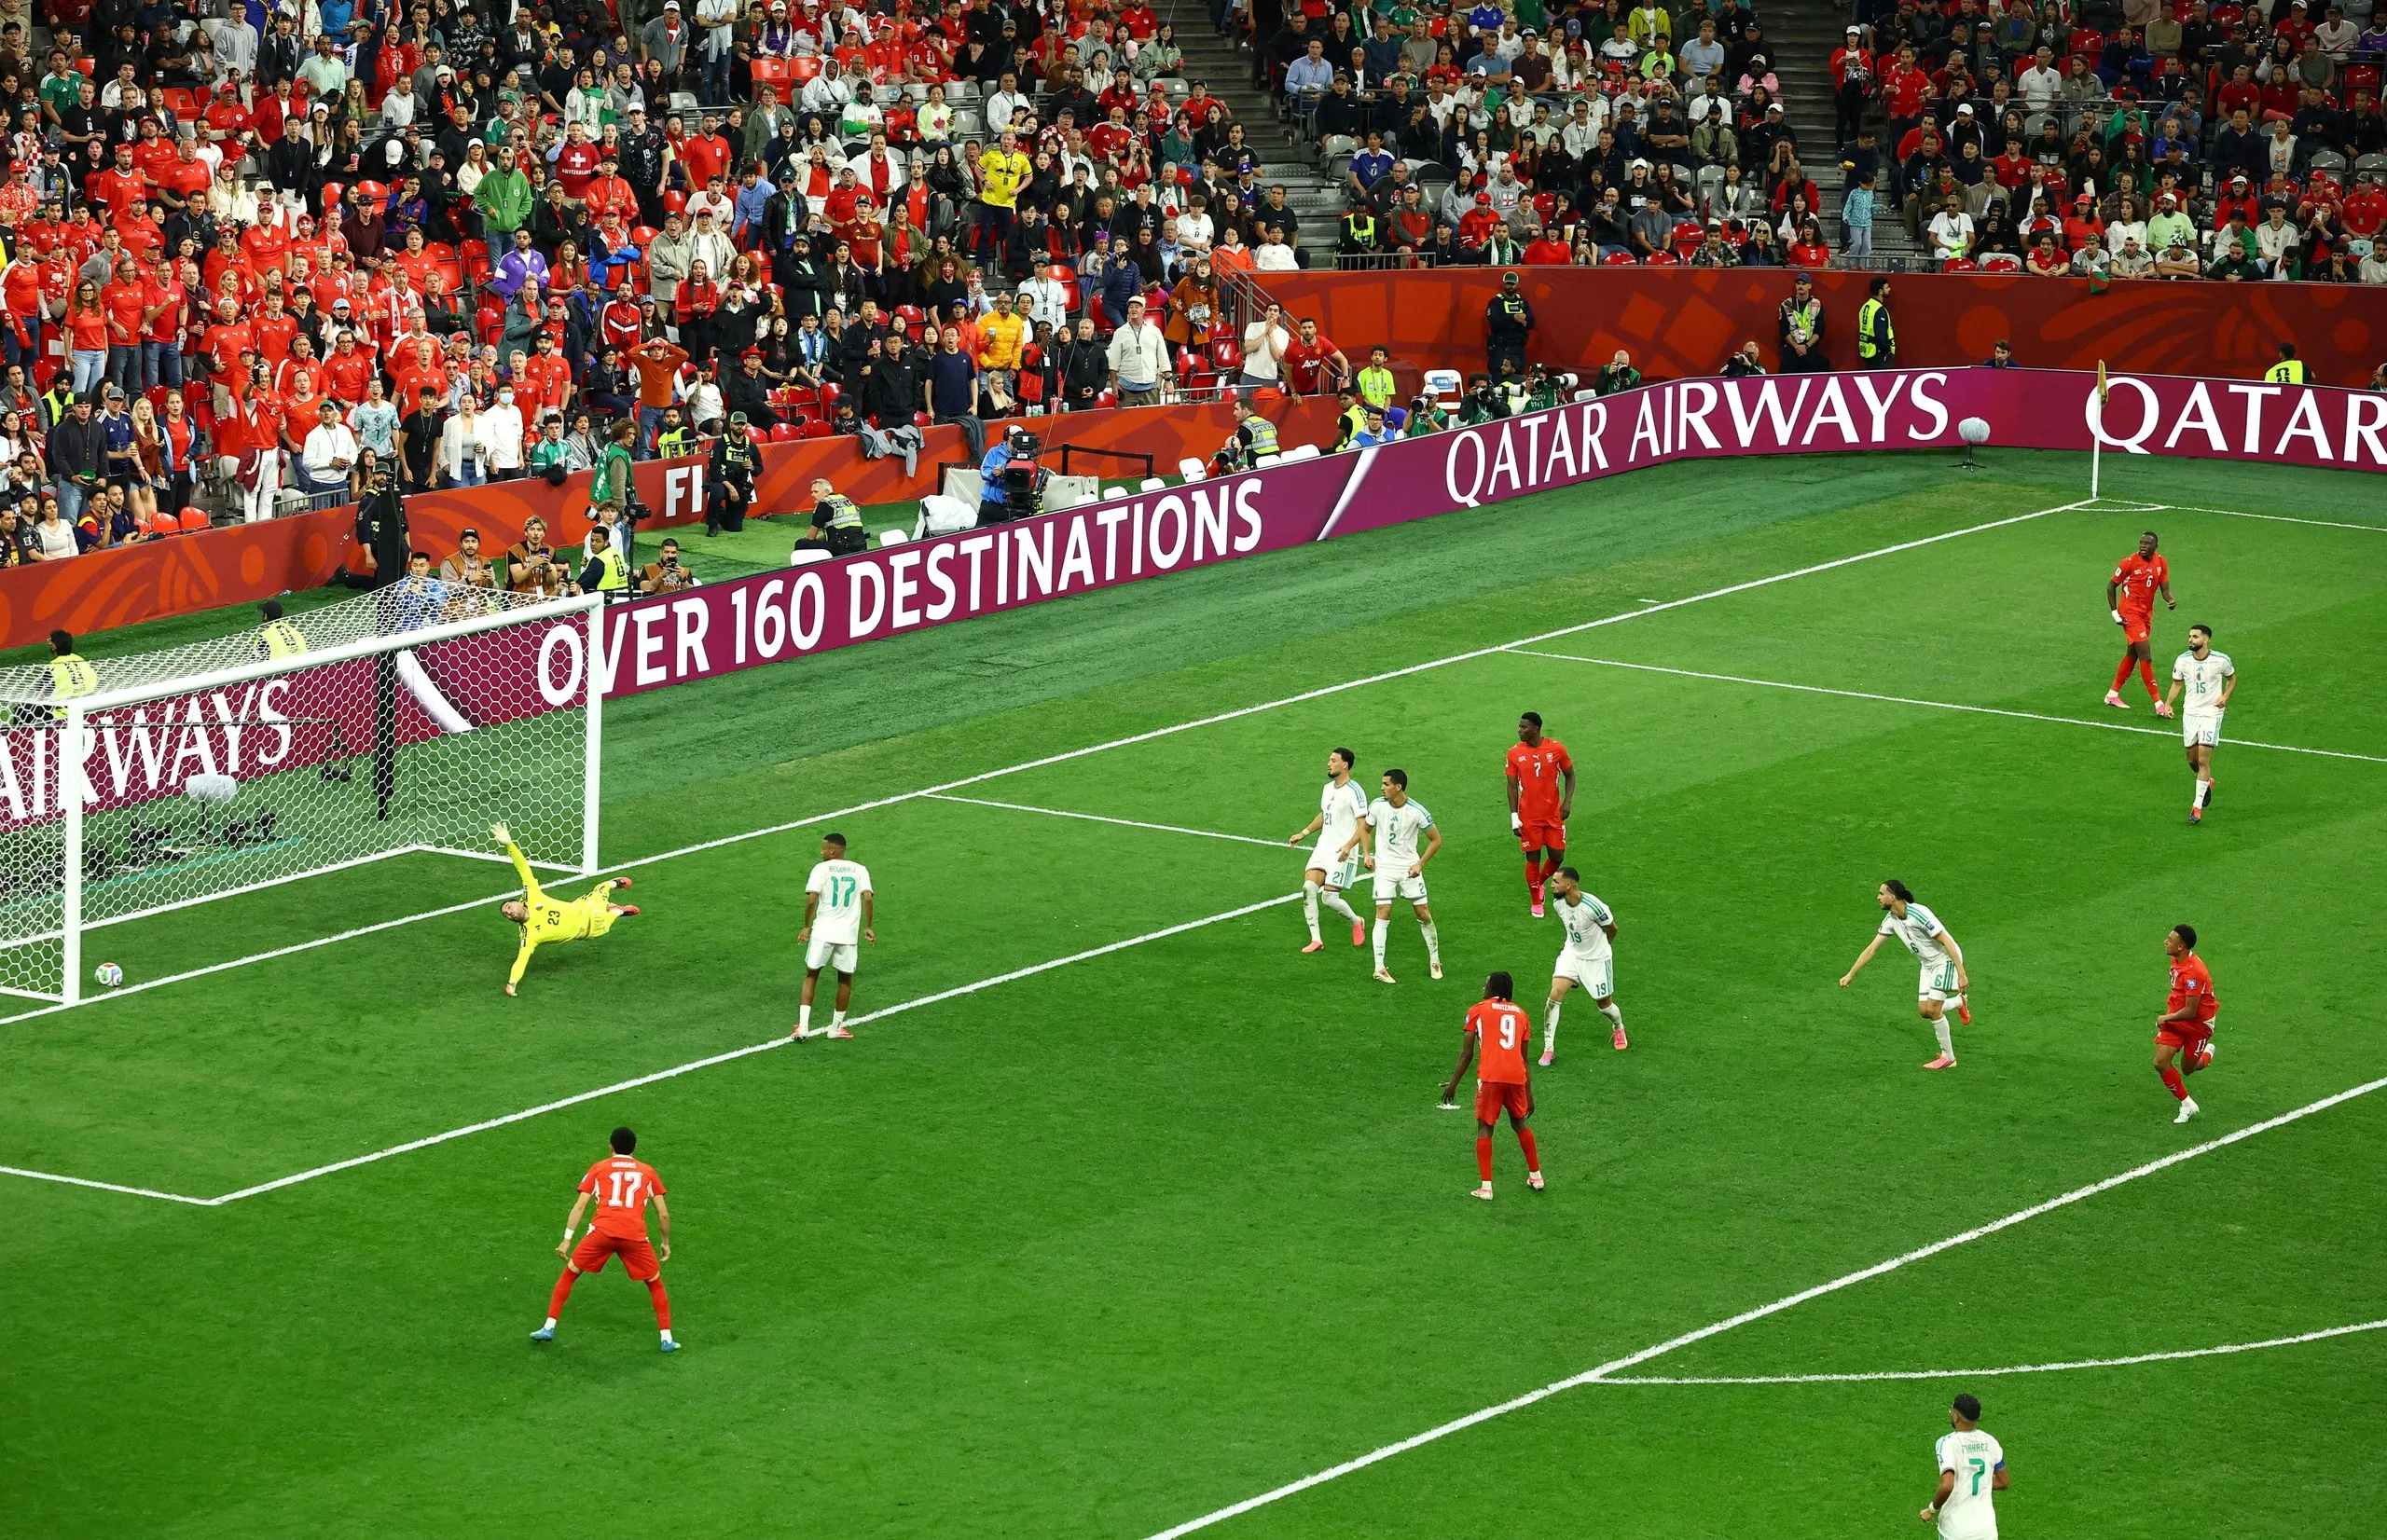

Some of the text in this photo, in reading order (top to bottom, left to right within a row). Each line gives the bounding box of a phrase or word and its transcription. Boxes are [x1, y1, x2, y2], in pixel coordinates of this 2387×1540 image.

[1301, 359, 1321, 369] AON
[2085, 377, 2387, 465] QATAR
[1446, 372, 1949, 508] QATAR AIRWAYS
[2146, 575, 2154, 588] 6
[537, 478, 1262, 707] OVER 160 DESTINATIONS
[2196, 681, 2206, 694] 15
[2202, 730, 2213, 742] 15
[1533, 762, 1541, 777] 7
[1324, 813, 1332, 826] 21
[1388, 832, 1397, 846] 2
[1331, 871, 1345, 885] 21
[831, 875, 856, 908] 17
[1418, 882, 1426, 895] 2
[547, 910, 560, 926] 23
[1569, 931, 1582, 943] 19
[1934, 974, 1943, 987] 6
[1595, 982, 1607, 997] 19
[1498, 1013, 1516, 1051] 9
[2194, 1038, 2207, 1053] 11
[608, 1171, 643, 1209] 17
[1962, 1443, 1989, 1453] MAHREZ
[1968, 1458, 1986, 1497] 7
